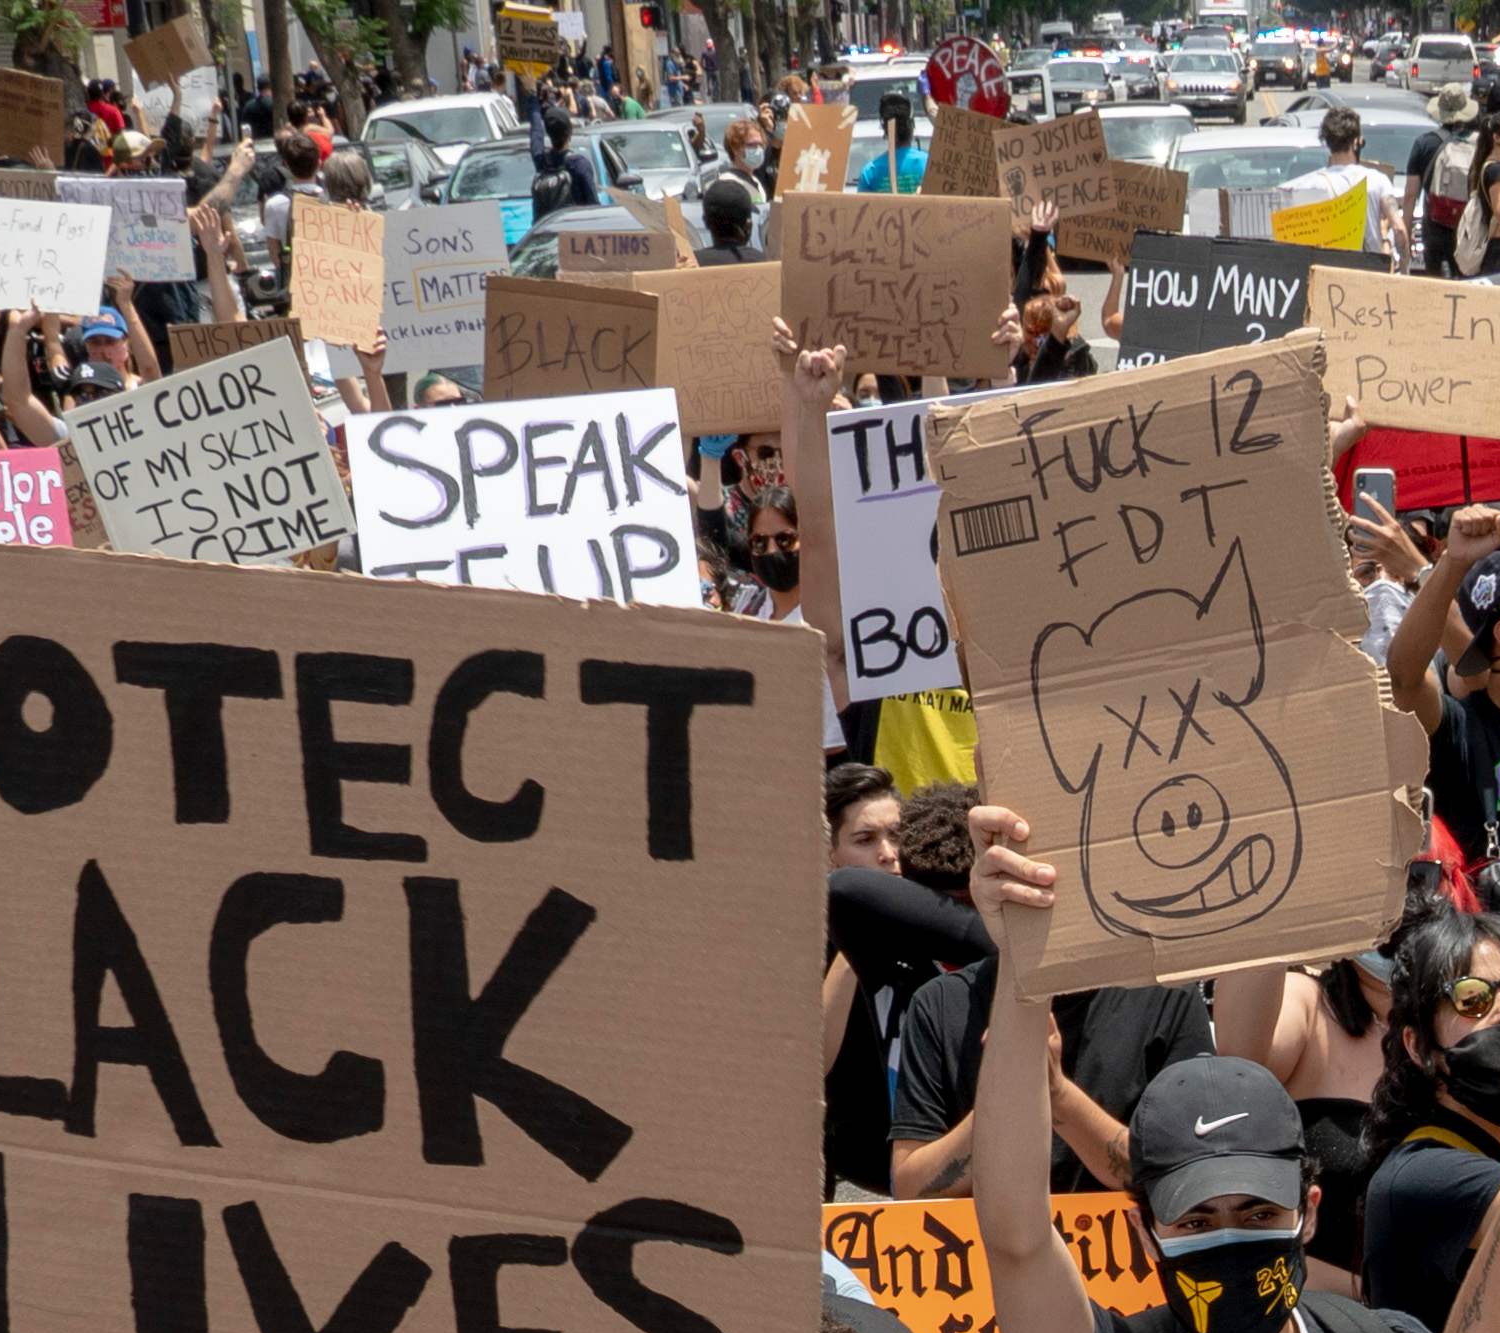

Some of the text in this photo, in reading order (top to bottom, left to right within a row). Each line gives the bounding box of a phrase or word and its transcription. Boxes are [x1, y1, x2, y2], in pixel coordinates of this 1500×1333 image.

[933, 39, 1008, 100] PEACE
[996, 116, 1100, 165] NO JUSTICE
[1041, 176, 1112, 209] PEACE
[301, 206, 380, 256] BREAK
[403, 226, 475, 256] SON'S
[569, 234, 651, 257] LATINOS
[801, 202, 932, 270] BLACK
[36, 248, 59, 276] 12
[294, 255, 363, 281] PIGGY
[1130, 262, 1300, 319] HOW MANY
[299, 281, 380, 307] BANK
[1327, 283, 1496, 345] Rest In
[491, 309, 655, 389] BLACK
[77, 363, 276, 453] THE COLOR
[1354, 354, 1473, 408] Power
[94, 459, 131, 502] OF
[143, 442, 194, 480] MY
[208, 409, 295, 473] SKIN
[1017, 400, 1189, 500] FUCK
[1208, 370, 1283, 458] 12
[135, 487, 220, 544] IS
[225, 454, 323, 520] NOT
[367, 410, 688, 530] SPEAK
[190, 497, 348, 556] CRIME
[825, 1207, 976, 1300] And
